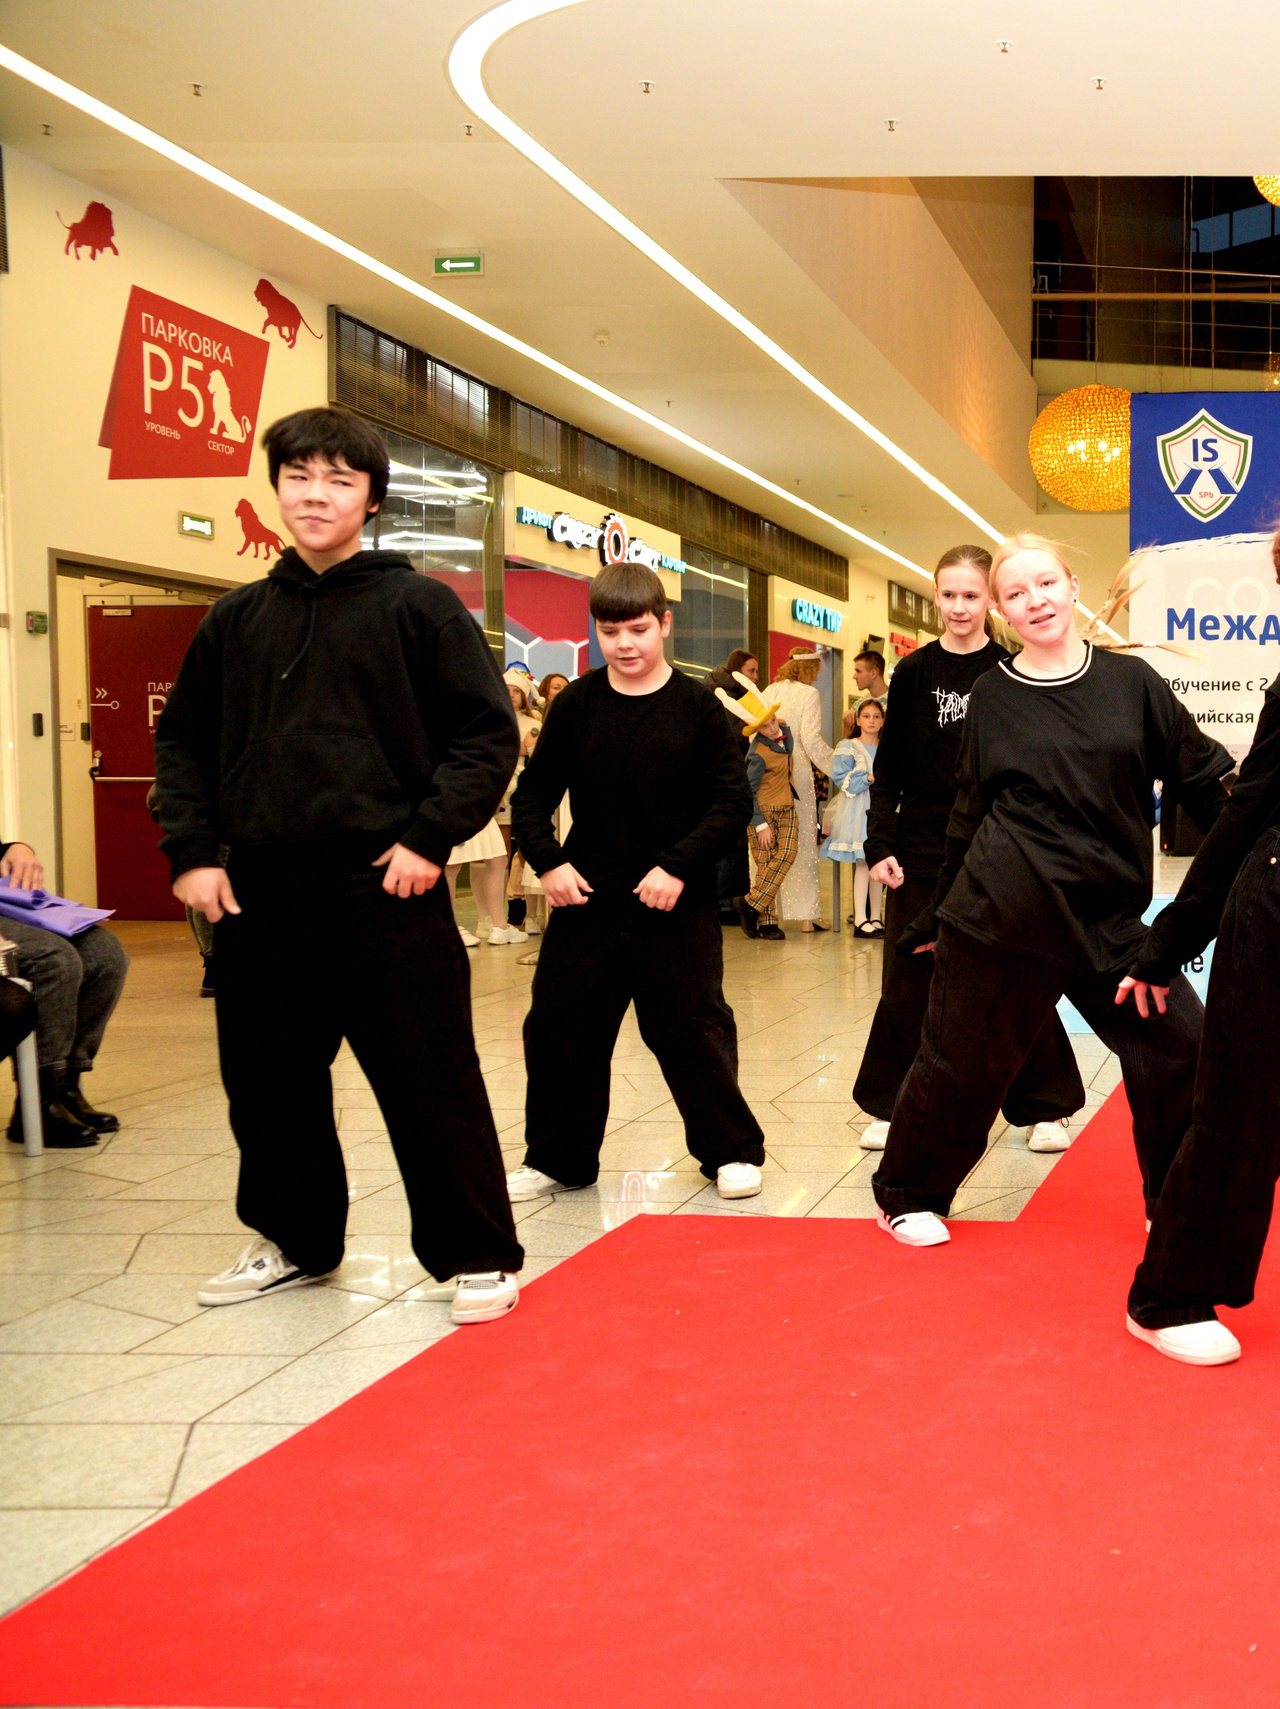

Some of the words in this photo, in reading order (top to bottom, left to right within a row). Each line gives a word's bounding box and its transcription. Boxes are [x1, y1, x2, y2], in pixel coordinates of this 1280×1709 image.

[142, 312, 233, 367] ПАРКОВКА
[143, 341, 204, 428] P5
[145, 421, 181, 440] УРОВЕНЬ
[207, 440, 235, 455] СЕКТОР
[1192, 438, 1219, 462] IS
[1198, 491, 1215, 499] SPb
[795, 598, 825, 629] CRAZY
[825, 607, 843, 633] ТИР
[1246, 680, 1254, 691] с
